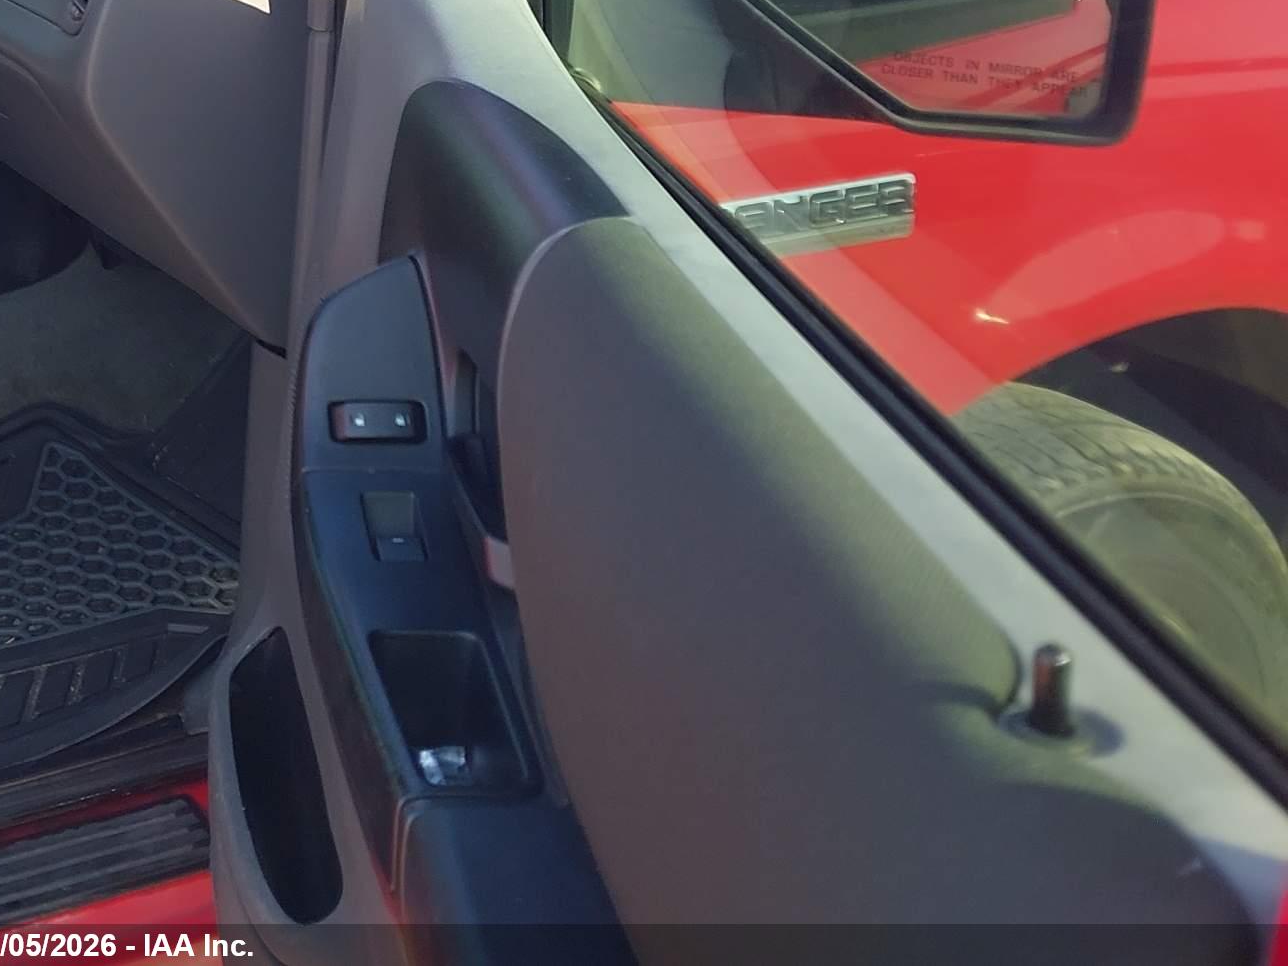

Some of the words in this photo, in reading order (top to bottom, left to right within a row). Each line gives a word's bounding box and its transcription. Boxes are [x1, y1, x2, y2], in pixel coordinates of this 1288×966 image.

[881, 64, 933, 80] CLOSER
[943, 70, 979, 85] THAN
[988, 76, 1020, 91] THEY
[1031, 81, 1088, 98] APPEAR
[893, 50, 954, 68] OBJECTS
[965, 59, 980, 71] IN
[988, 62, 1043, 78] MIRROR
[1049, 68, 1077, 82] ARE
[731, 177, 915, 238] ANGER
